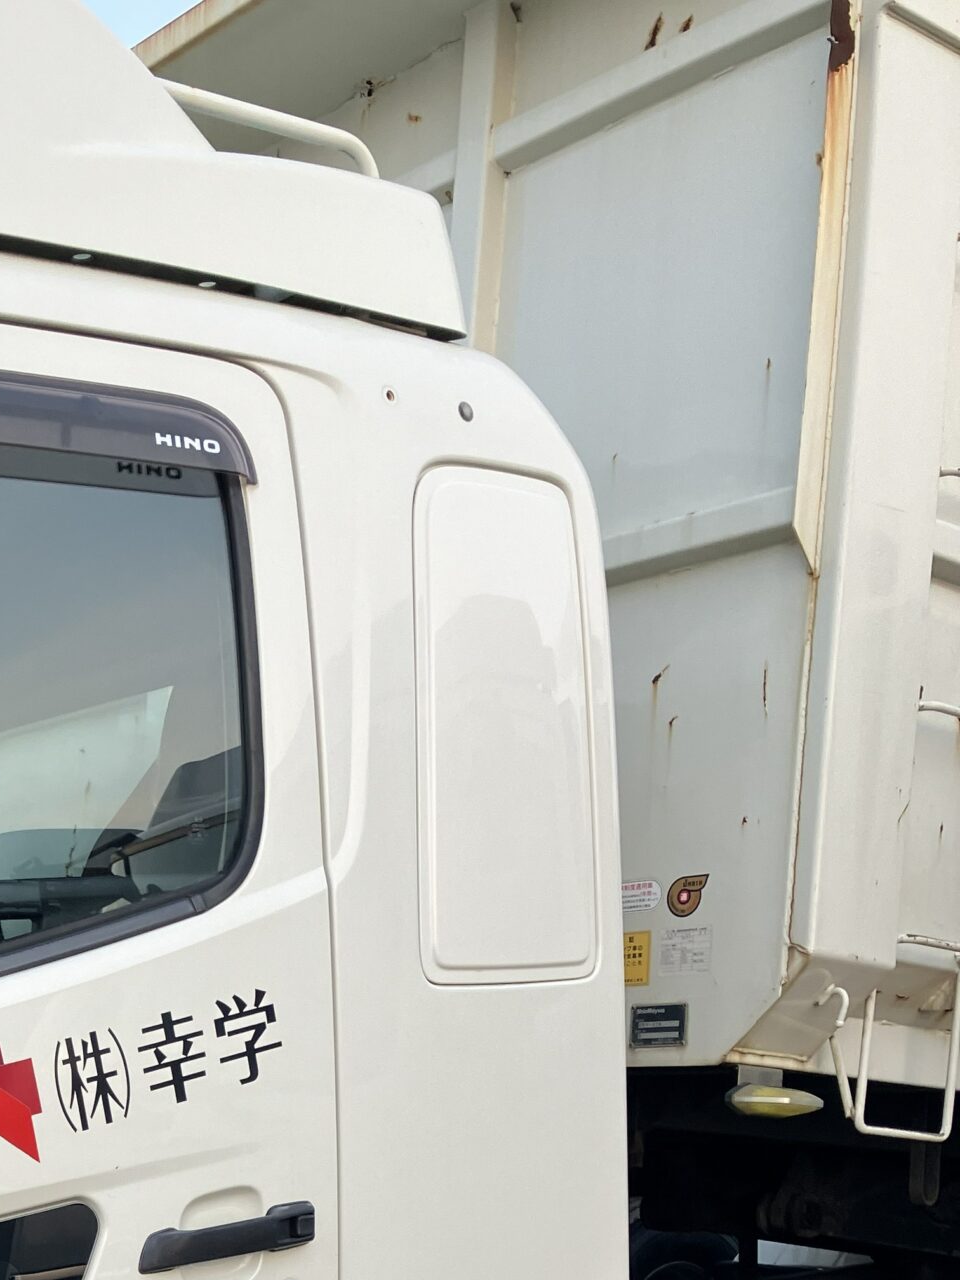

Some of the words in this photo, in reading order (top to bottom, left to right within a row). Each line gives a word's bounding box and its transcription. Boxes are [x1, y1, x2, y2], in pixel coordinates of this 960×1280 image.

[155, 432, 221, 454] HINO
[116, 461, 183, 480] HINO
[54, 988, 283, 1133] (株)幸学
